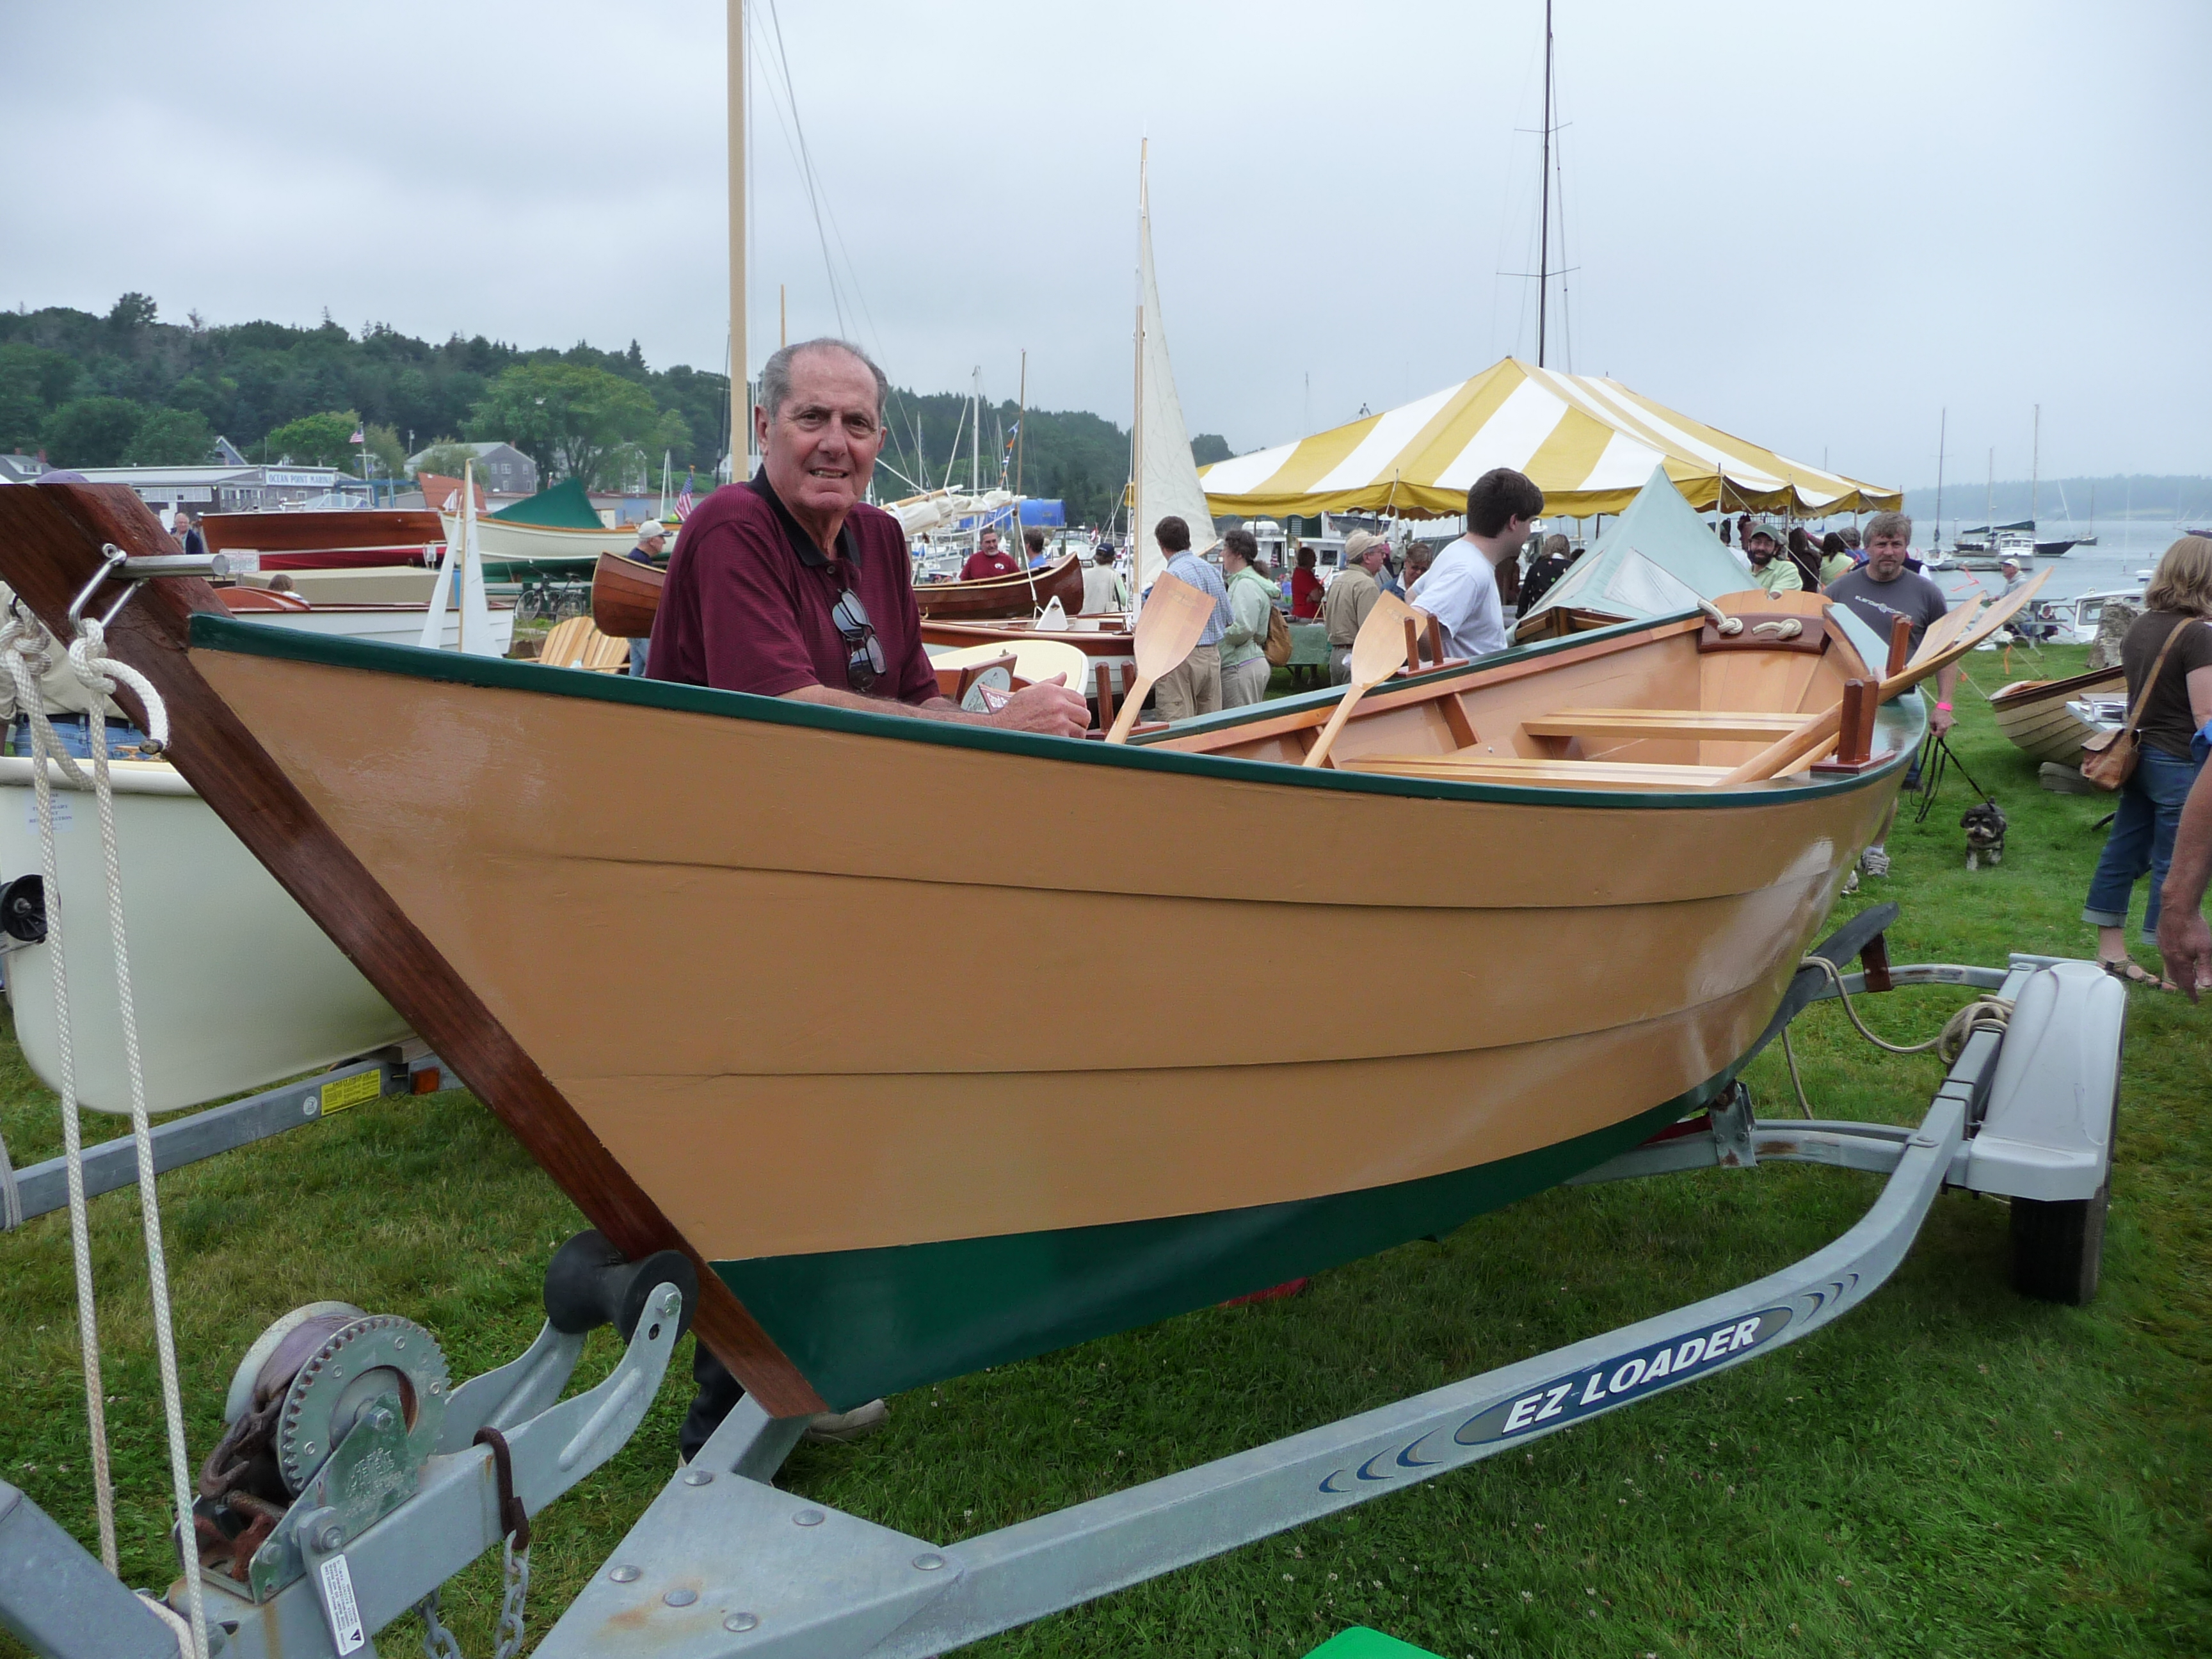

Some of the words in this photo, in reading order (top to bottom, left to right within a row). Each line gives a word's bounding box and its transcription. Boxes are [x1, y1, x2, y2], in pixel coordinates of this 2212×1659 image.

[269, 474, 289, 483] OCEAN
[291, 475, 308, 483] POINT
[1502, 1382, 1573, 1434] EZ
[1580, 1317, 1761, 1406] LOADER
